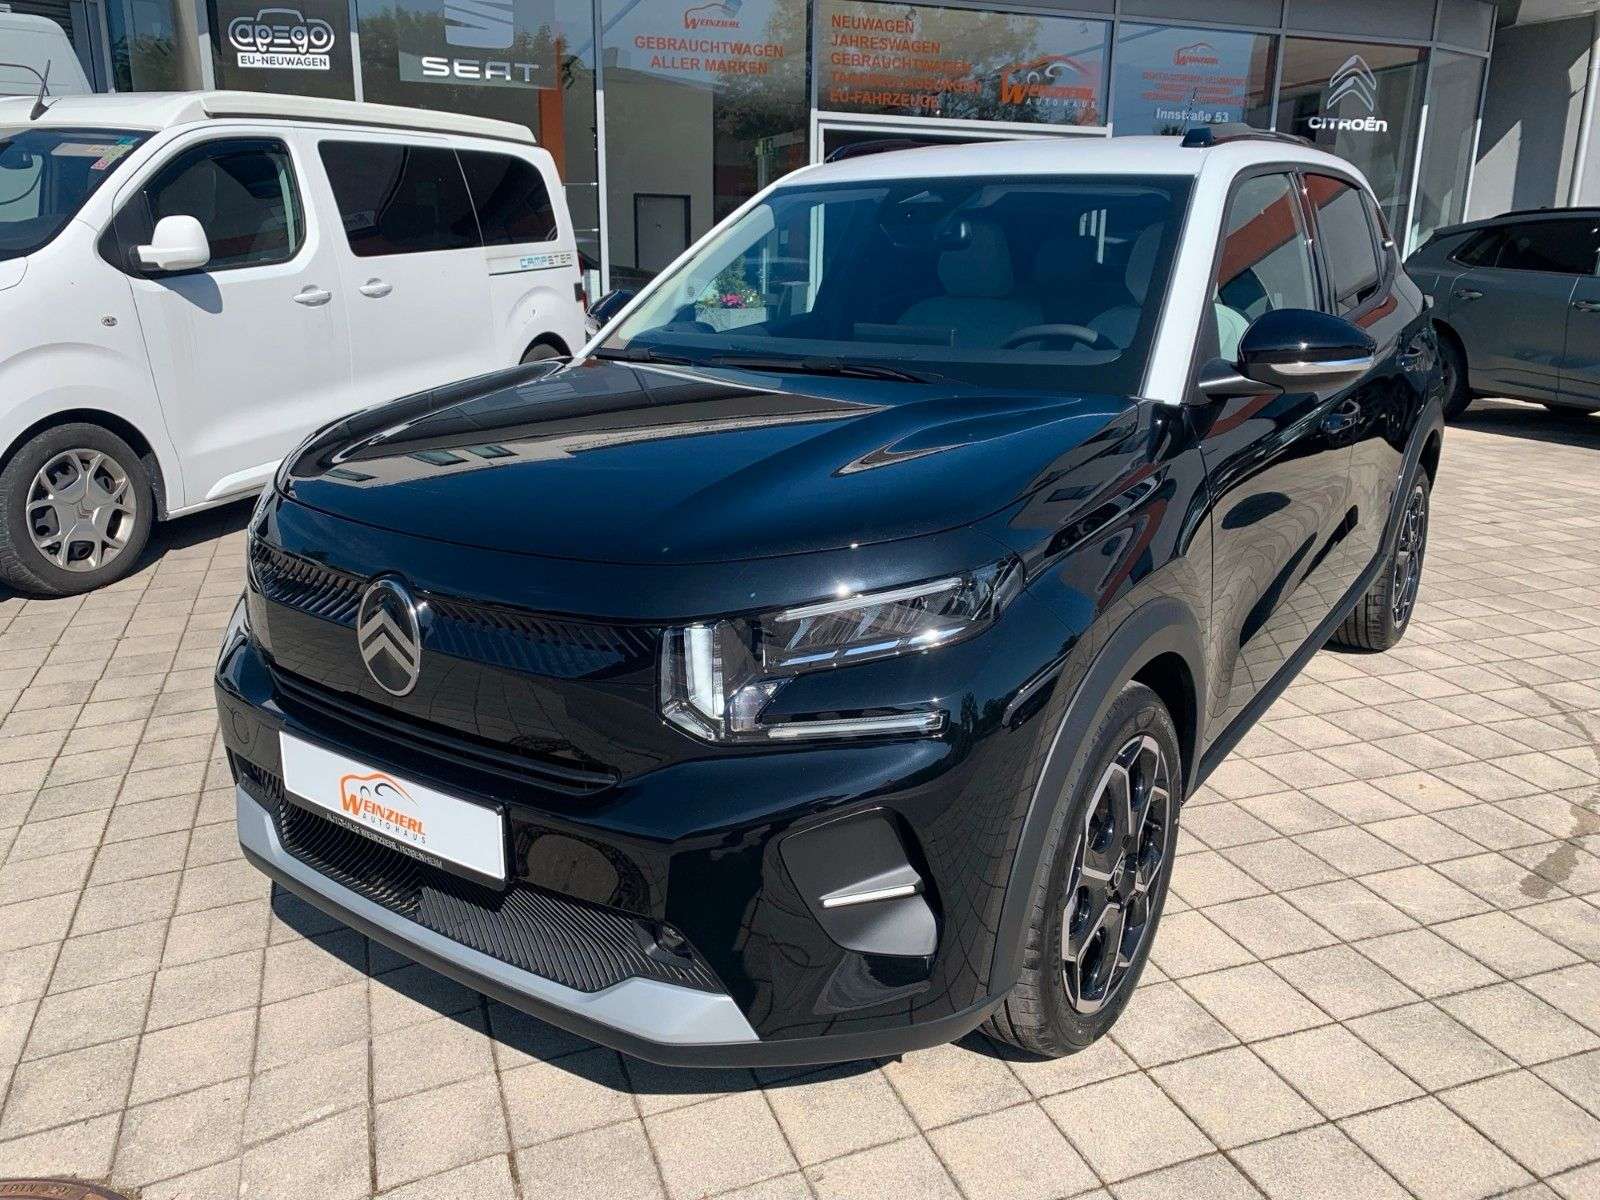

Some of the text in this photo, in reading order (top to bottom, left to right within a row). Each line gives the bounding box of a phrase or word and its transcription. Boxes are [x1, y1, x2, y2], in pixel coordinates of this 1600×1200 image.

[831, 14, 914, 33] NEUWAGEN
[634, 35, 784, 58] GEBRAUCHTWAGEN
[831, 34, 941, 54] JAHRESWAGEN
[240, 55, 327, 67] EU-NEUWAGEN
[422, 57, 539, 82] SEAT
[651, 55, 768, 75] ALLER MARKEN
[1214, 111, 1229, 122] 53
[341, 794, 426, 835] WEINZIERL
[362, 812, 427, 845] AUTOHAUS
